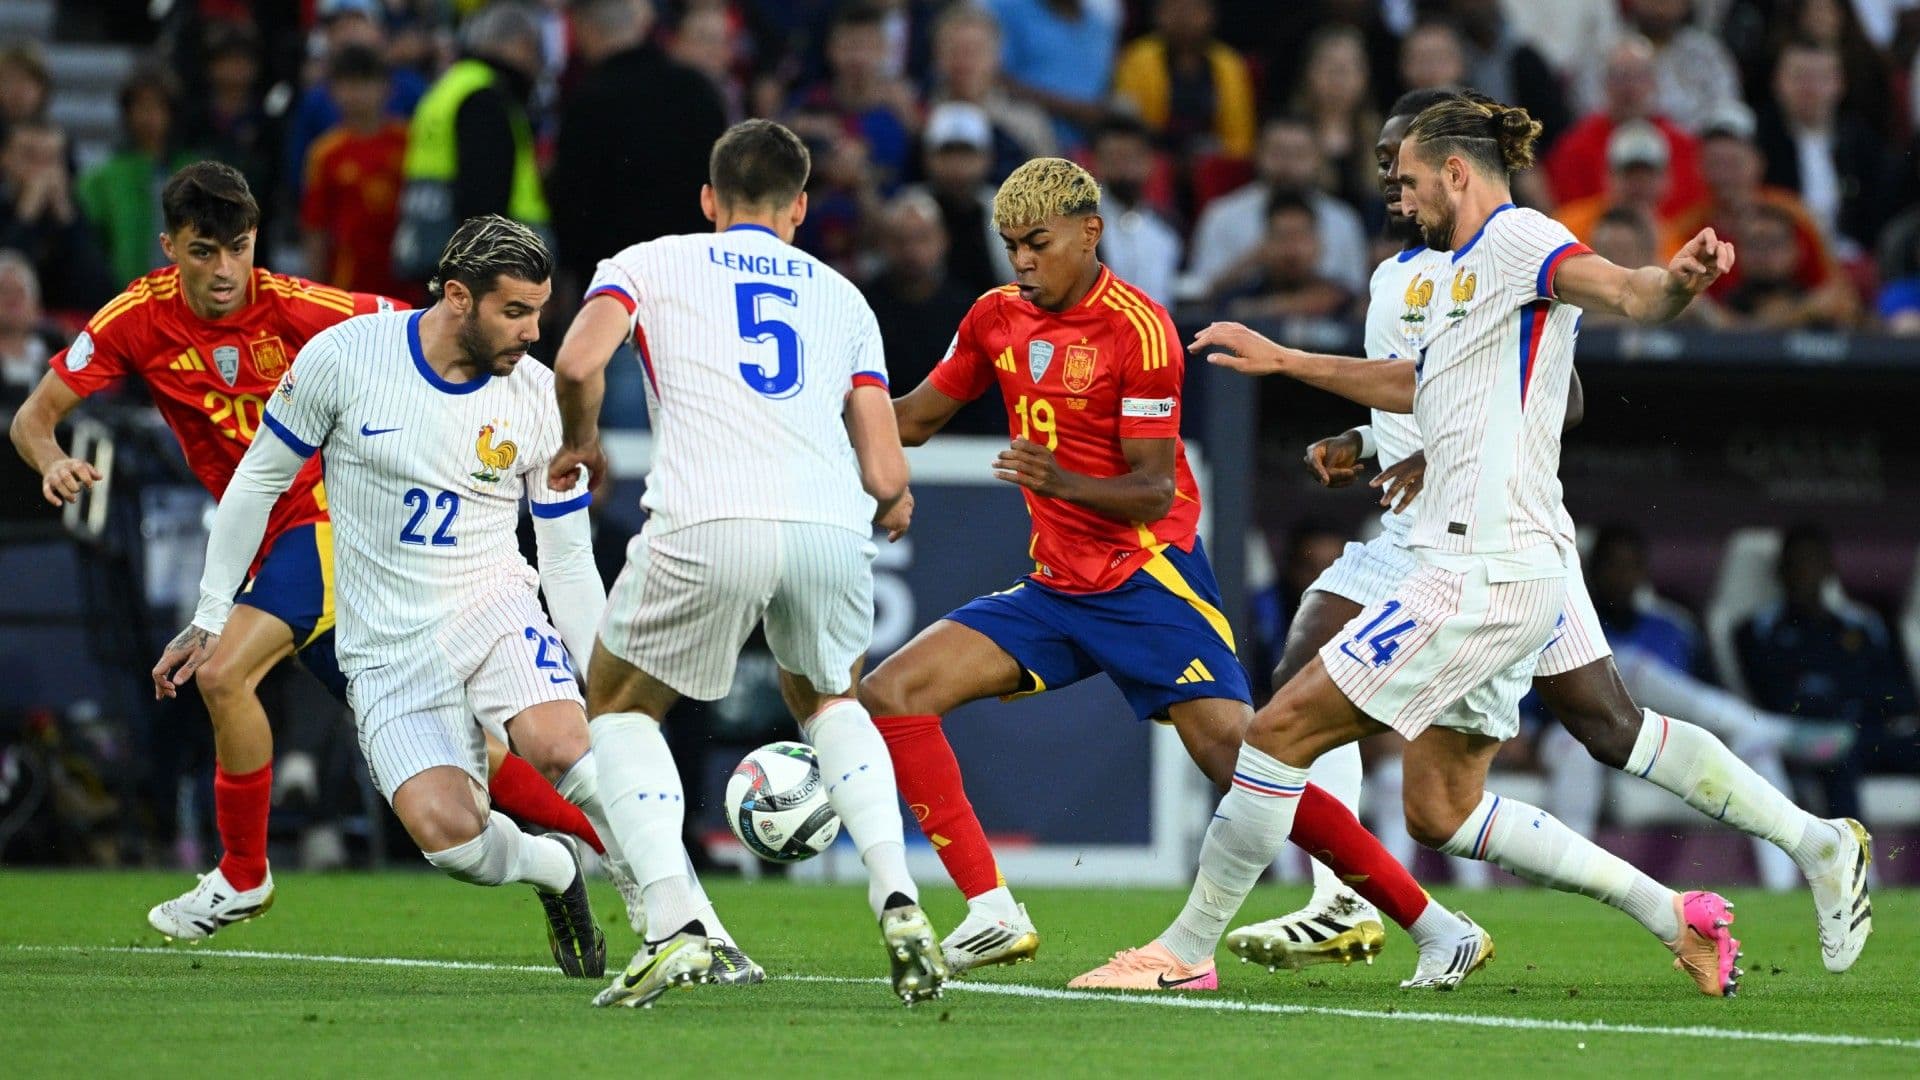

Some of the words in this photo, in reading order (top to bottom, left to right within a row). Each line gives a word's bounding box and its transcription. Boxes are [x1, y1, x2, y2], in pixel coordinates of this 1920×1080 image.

[709, 247, 813, 278] LENGLET
[735, 282, 804, 400] 5
[204, 391, 265, 441] 20
[1015, 395, 1058, 452] 19
[400, 488, 460, 546] 22
[1354, 600, 1417, 668] 14
